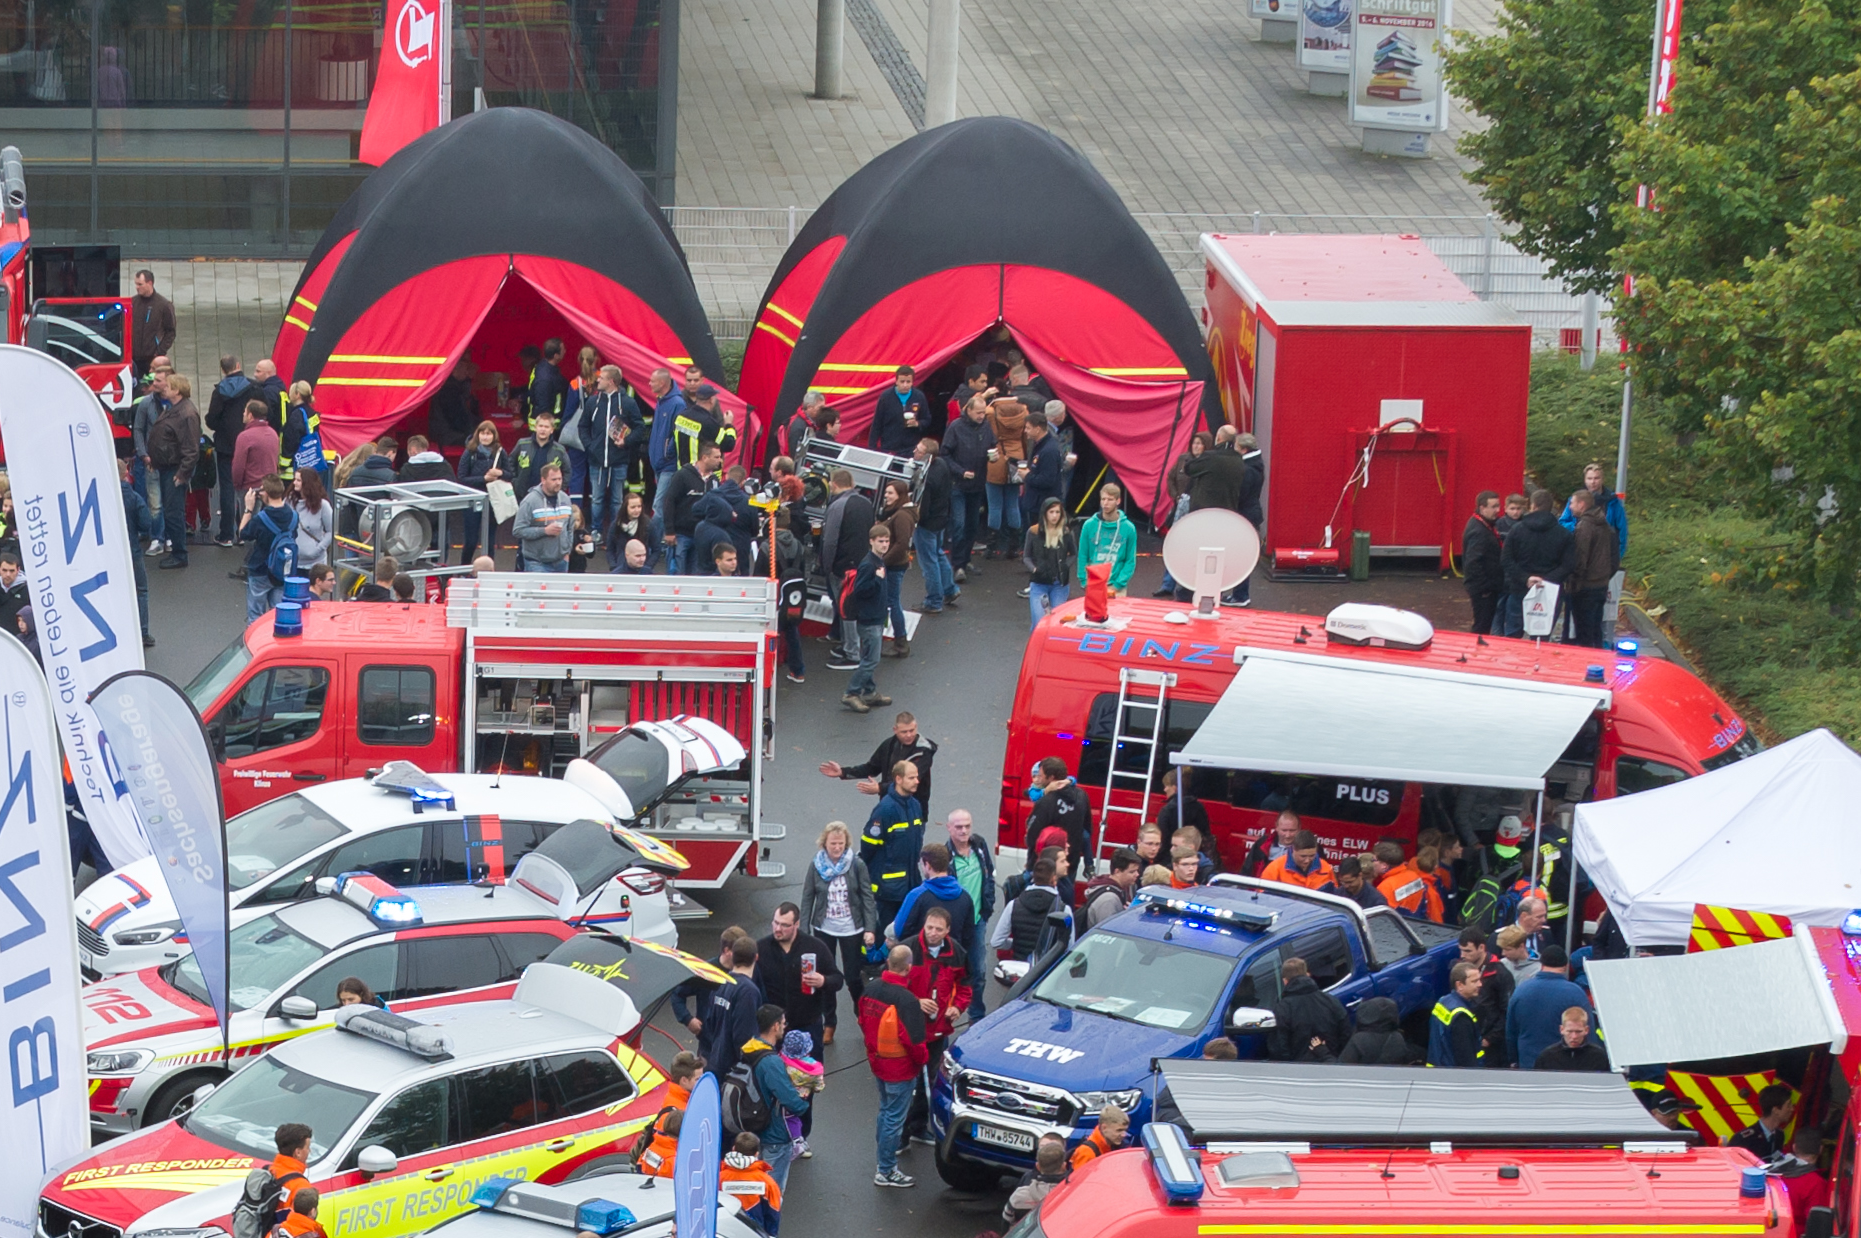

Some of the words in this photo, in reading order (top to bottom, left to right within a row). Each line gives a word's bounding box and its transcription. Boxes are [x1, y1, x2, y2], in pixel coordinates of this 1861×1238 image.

[1361, 0, 1436, 15] schriftgut
[1379, 17, 1416, 27] NOVEMBER
[1417, 19, 1433, 28] 2016
[1077, 632, 1221, 666] BINZ
[1713, 719, 1743, 749] BINZ
[1336, 783, 1390, 805] PLUS
[1342, 838, 1368, 849] ELW
[1004, 1037, 1085, 1065] THW
[979, 1126, 997, 1140] THW
[1003, 1131, 1032, 1148] 85744
[63, 1163, 122, 1186] FIRST
[125, 1157, 253, 1174] RESPONDER
[336, 1196, 396, 1236] FIRST
